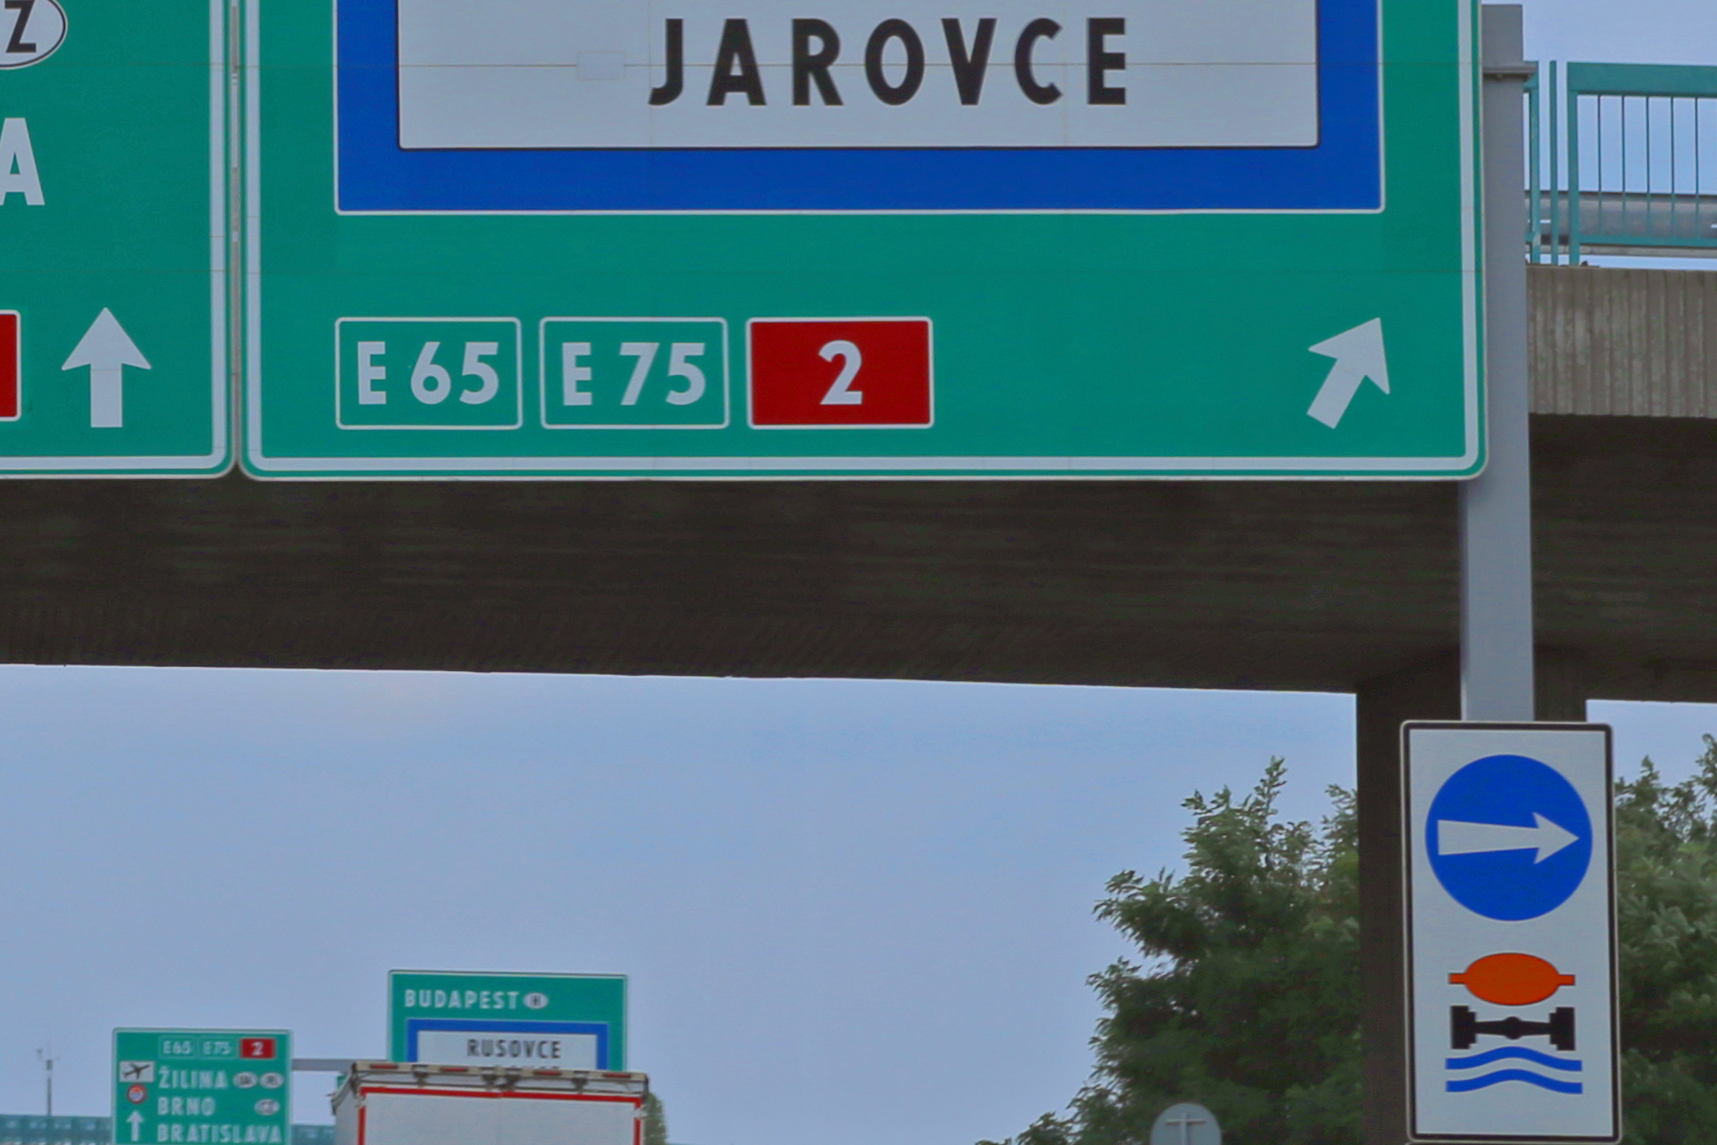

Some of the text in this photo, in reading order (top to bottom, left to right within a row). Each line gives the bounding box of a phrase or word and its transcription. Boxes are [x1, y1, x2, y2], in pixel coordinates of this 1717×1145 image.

[647, 16, 1128, 107] JAROVCE
[818, 339, 863, 405] 2
[404, 989, 519, 1009] BUDAPEST
[251, 1041, 264, 1055] 2
[467, 1039, 561, 1058] RUSOVCE
[158, 1066, 229, 1089] ŽILINA
[158, 1096, 215, 1116] BRNO
[157, 1123, 282, 1142] BRATISLAVA
